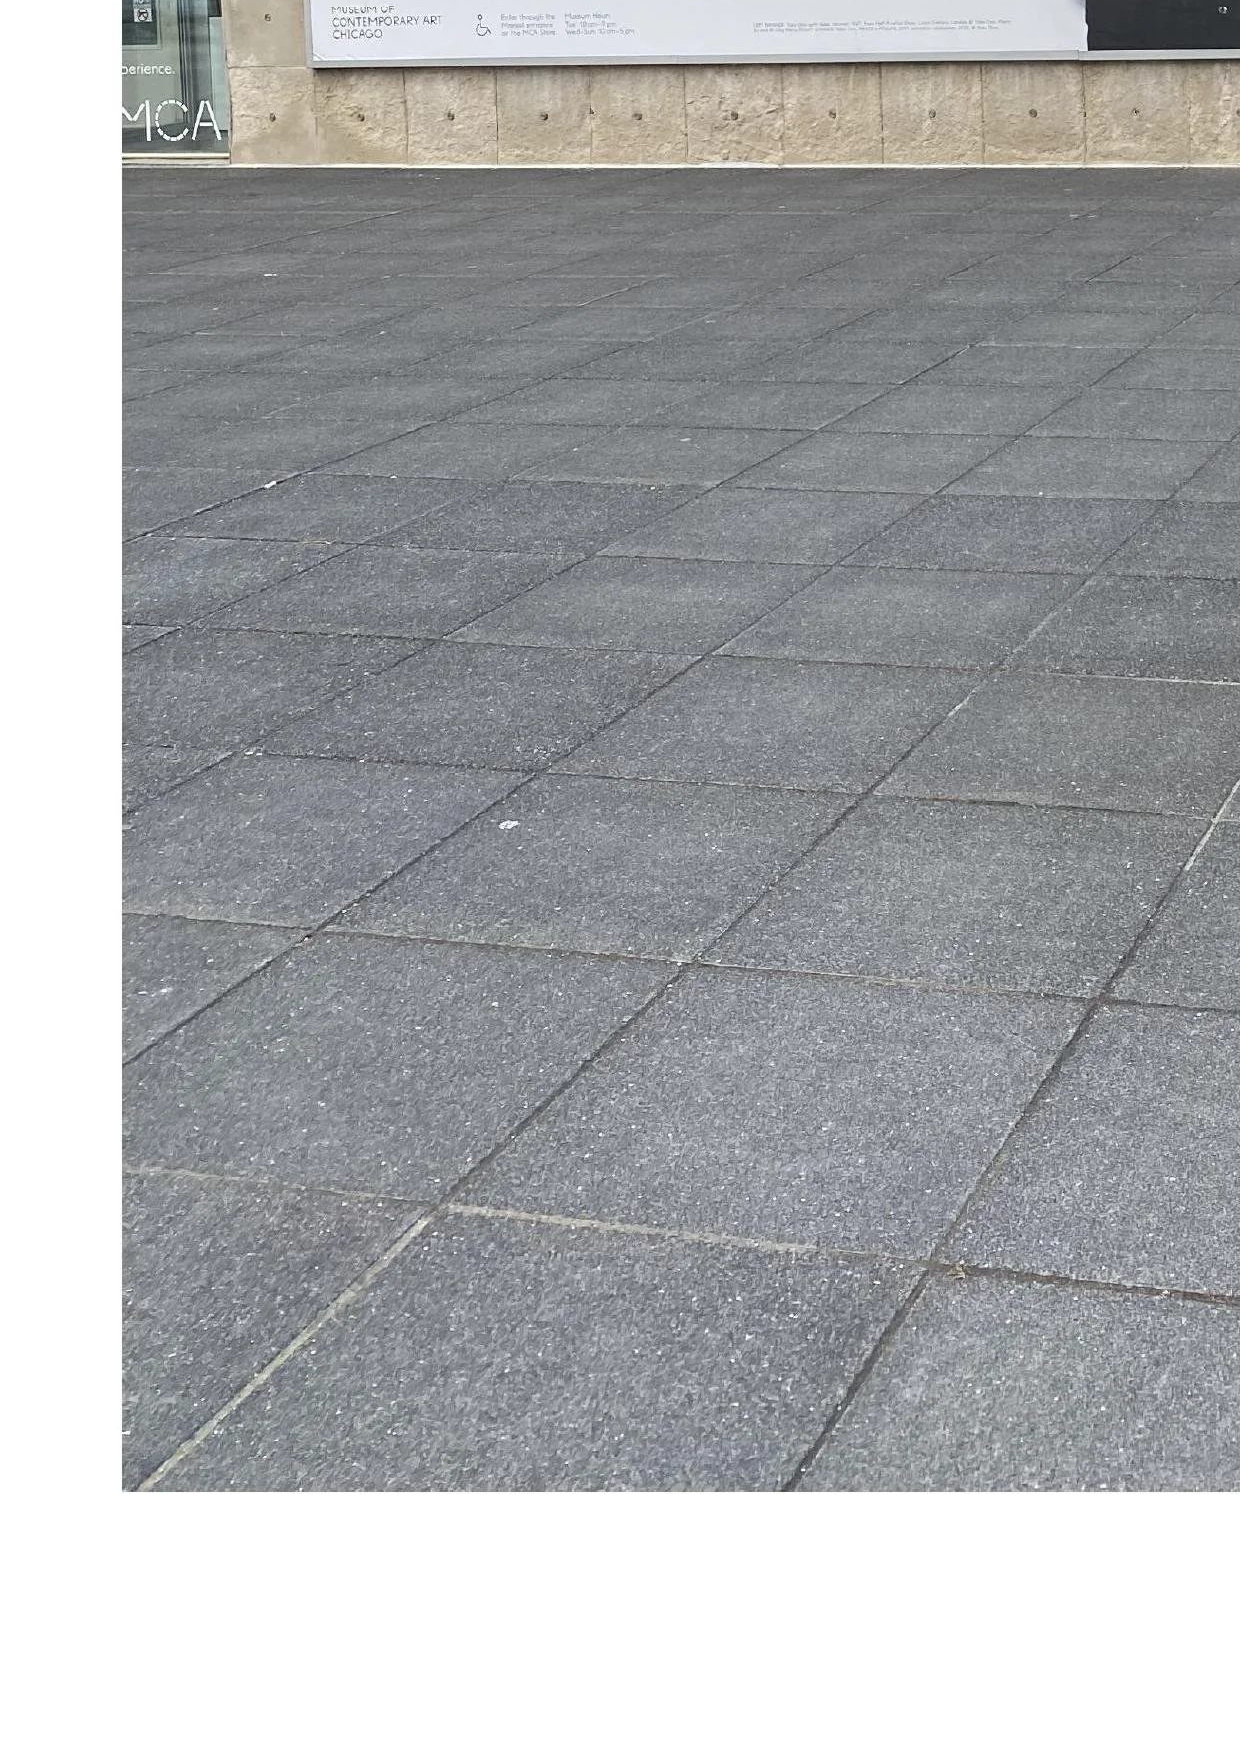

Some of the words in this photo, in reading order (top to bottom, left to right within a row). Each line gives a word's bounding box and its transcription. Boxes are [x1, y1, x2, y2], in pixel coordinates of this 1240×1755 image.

[331, 5, 377, 14] MUSEUM
[332, 15, 420, 28] CONTEMPORARY
[422, 15, 442, 26] ART
[332, 28, 383, 40] CHICAGO
[122, 98, 222, 142] MCA
